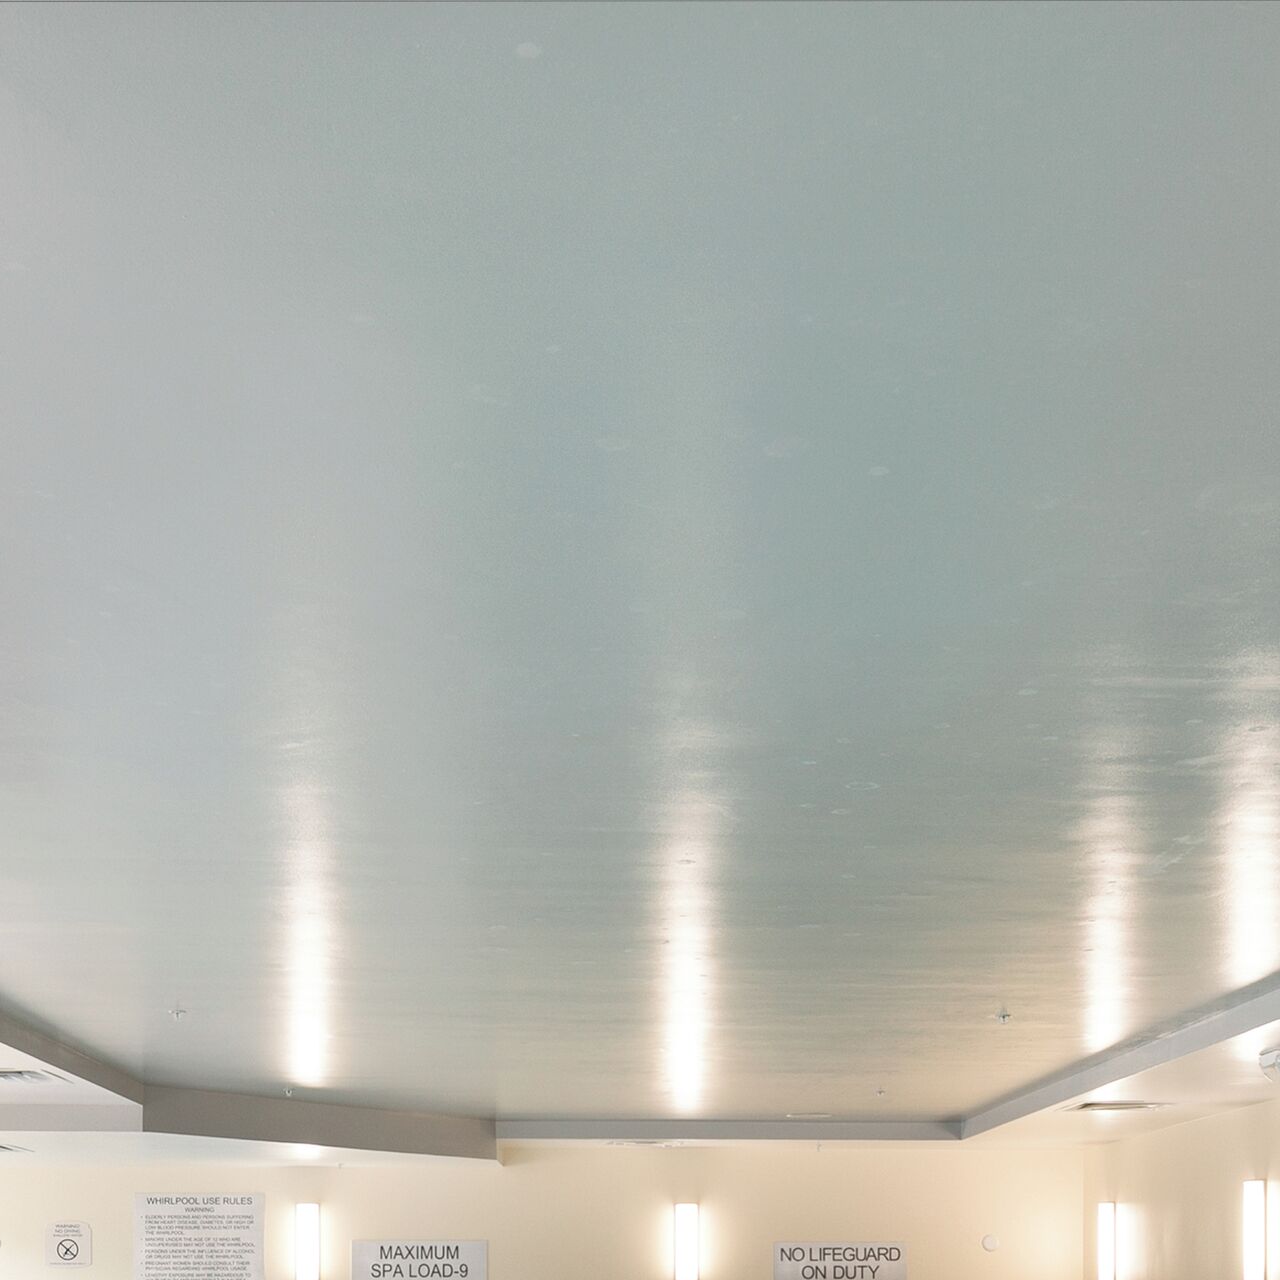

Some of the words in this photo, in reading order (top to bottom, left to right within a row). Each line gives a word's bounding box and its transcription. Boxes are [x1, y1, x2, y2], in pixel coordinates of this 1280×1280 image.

[146, 1197, 200, 1205] WHIRLPOOL
[202, 1197, 221, 1205] USE
[223, 1197, 253, 1205] RULES
[379, 1245, 460, 1260] MAXIMUM
[780, 1247, 805, 1262] NO
[809, 1247, 901, 1262] LIFEGUARD
[371, 1263, 404, 1278] SPA
[408, 1263, 469, 1278] LOAD-9
[801, 1265, 827, 1280] ON
[833, 1265, 880, 1280] DUTY
